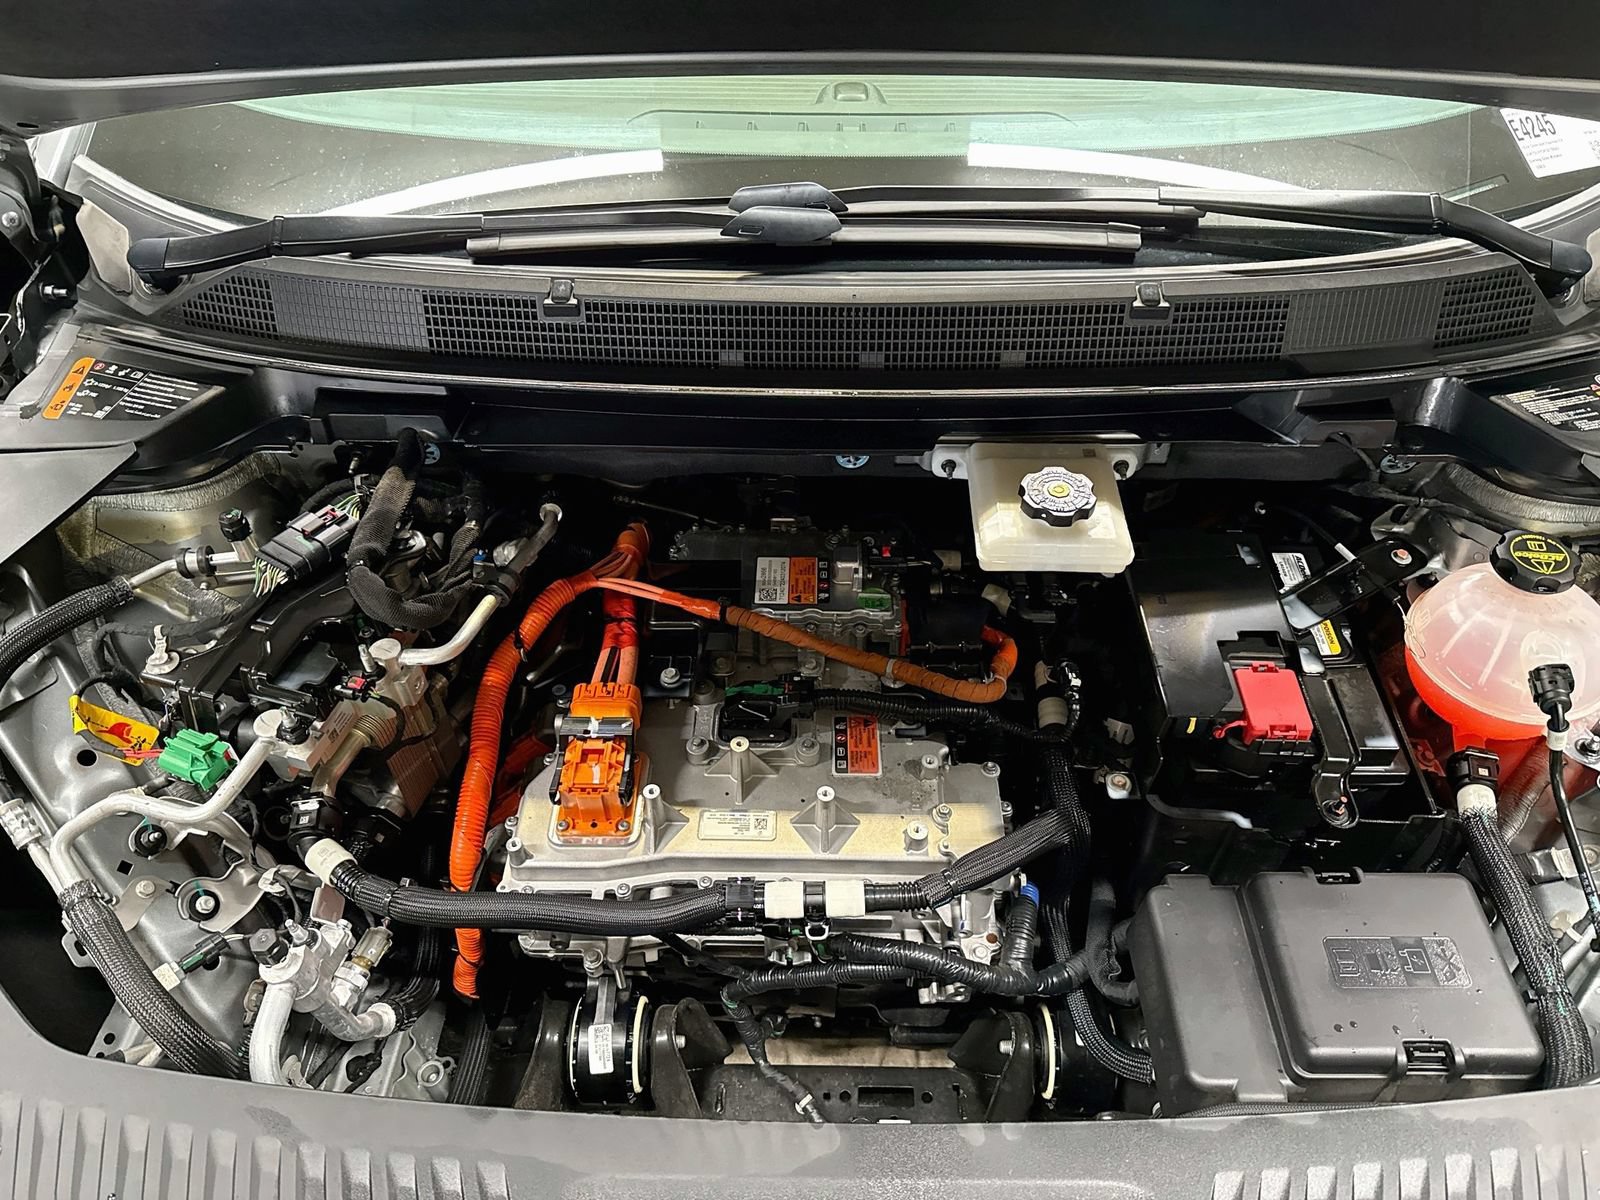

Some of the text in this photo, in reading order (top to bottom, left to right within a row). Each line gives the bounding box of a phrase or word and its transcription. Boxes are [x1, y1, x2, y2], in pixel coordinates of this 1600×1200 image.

[1508, 114, 1556, 141] E4245
[1514, 551, 1566, 561] ACDelco
[1323, 622, 1336, 645] POISON
